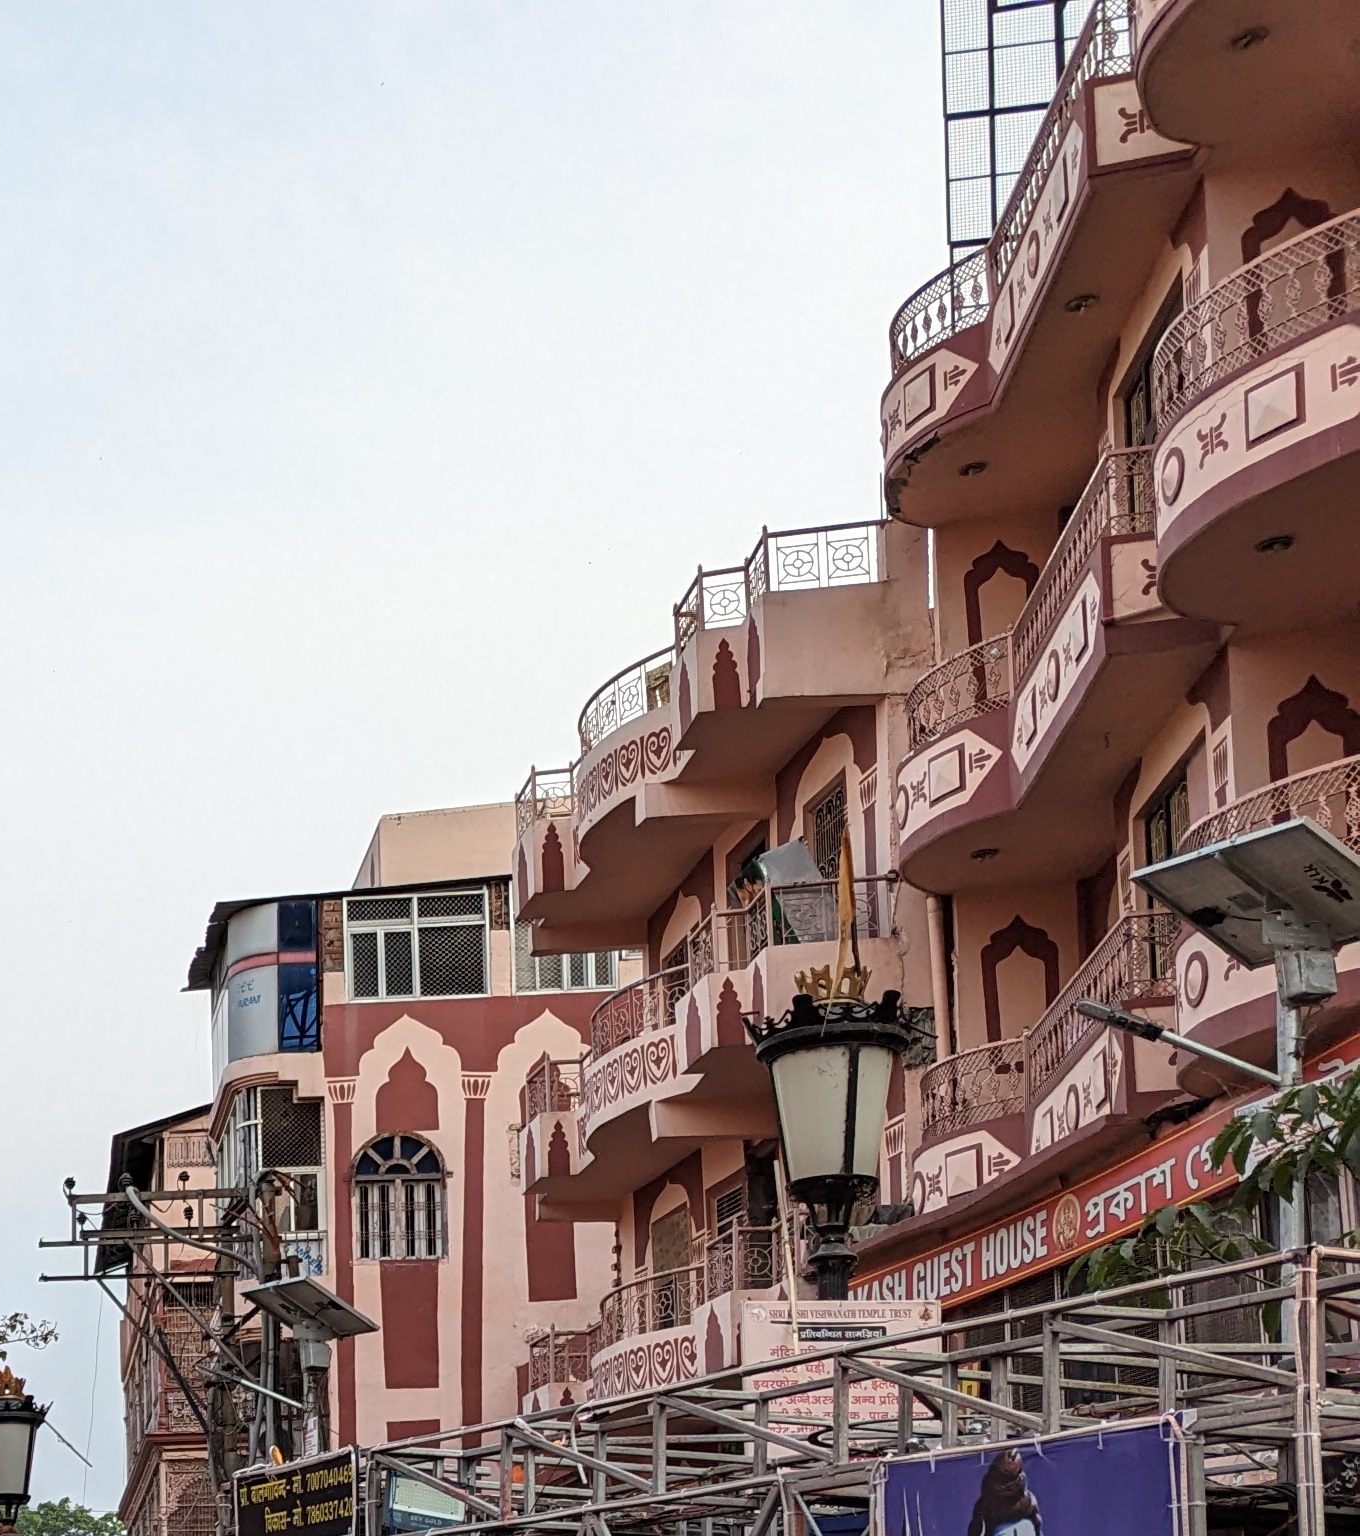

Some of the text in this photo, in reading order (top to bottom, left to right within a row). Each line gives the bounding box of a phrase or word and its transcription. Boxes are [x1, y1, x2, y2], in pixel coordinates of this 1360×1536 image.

[1085, 1157, 1177, 1240] প্রকাশ
[912, 1241, 976, 1302] GUEST
[981, 1208, 1049, 1281] HOUSE
[769, 1308, 913, 1319] SHRI KSHI VISHWANATH TEMPLE TRUST
[306, 1497, 353, 1525] 7860337420
